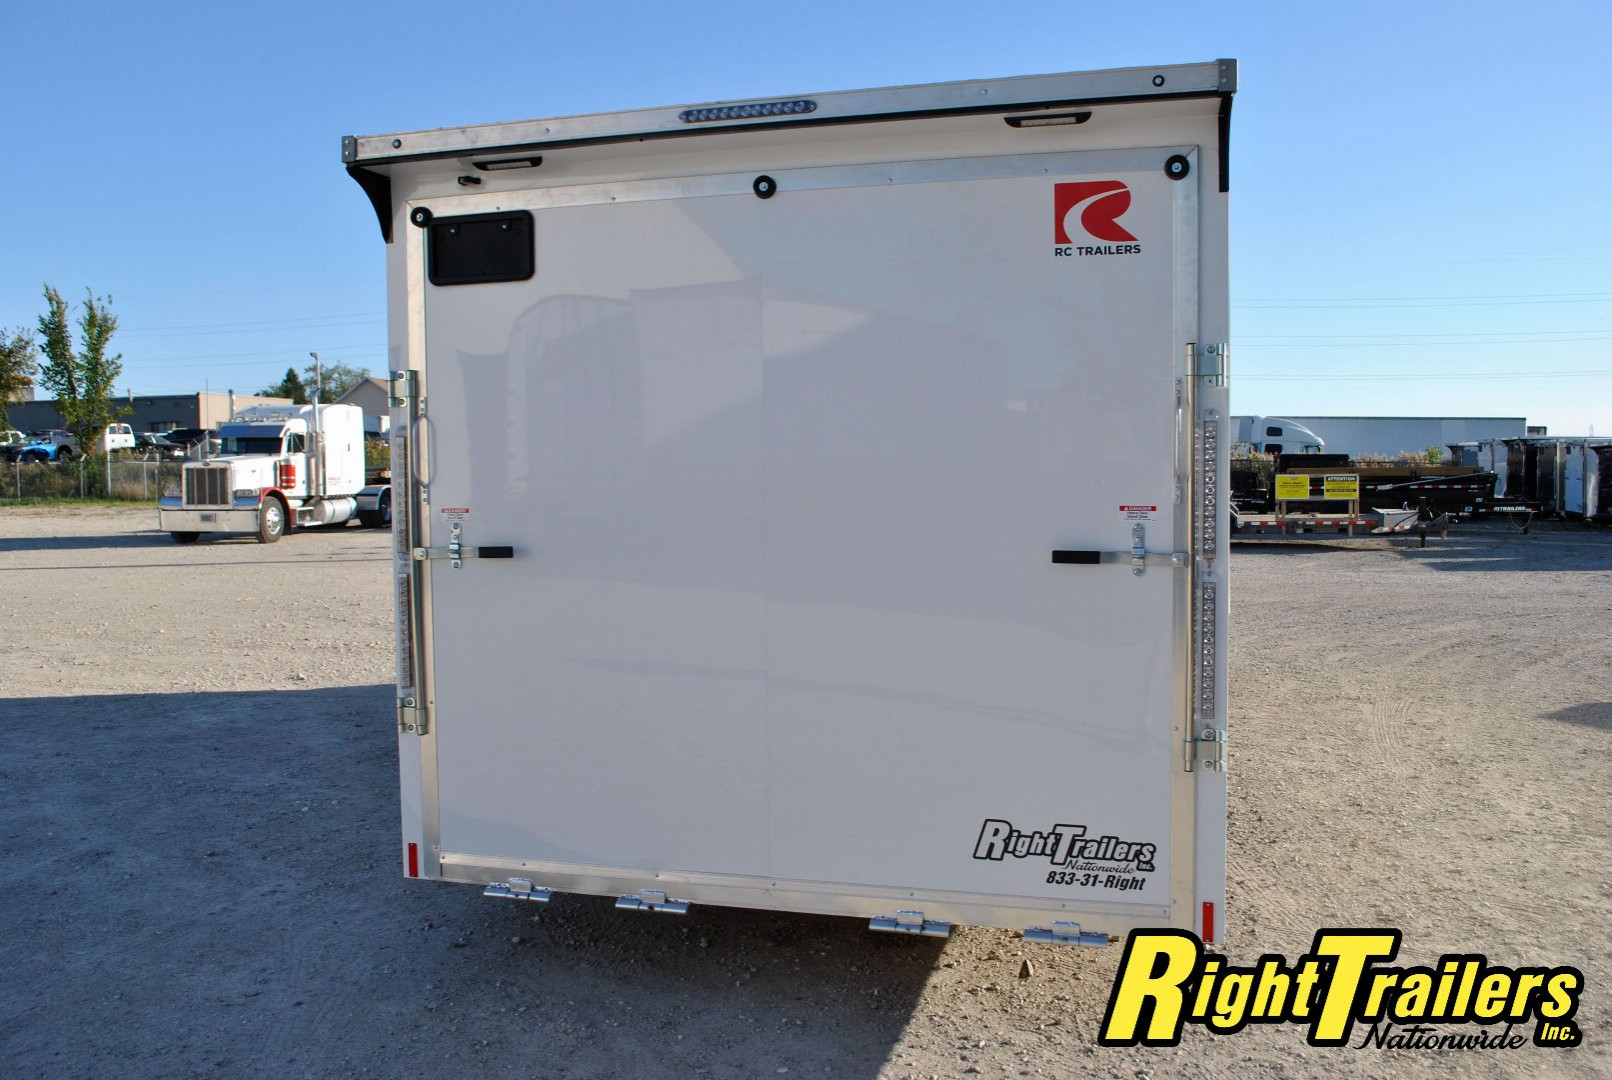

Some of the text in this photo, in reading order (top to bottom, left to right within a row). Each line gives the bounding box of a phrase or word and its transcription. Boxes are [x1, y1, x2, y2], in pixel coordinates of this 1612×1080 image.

[1055, 245, 1141, 256] RC TRAILERS
[1063, 859, 1155, 874] Nationwide Inc.
[1046, 871, 1146, 891] 833-31-Right
